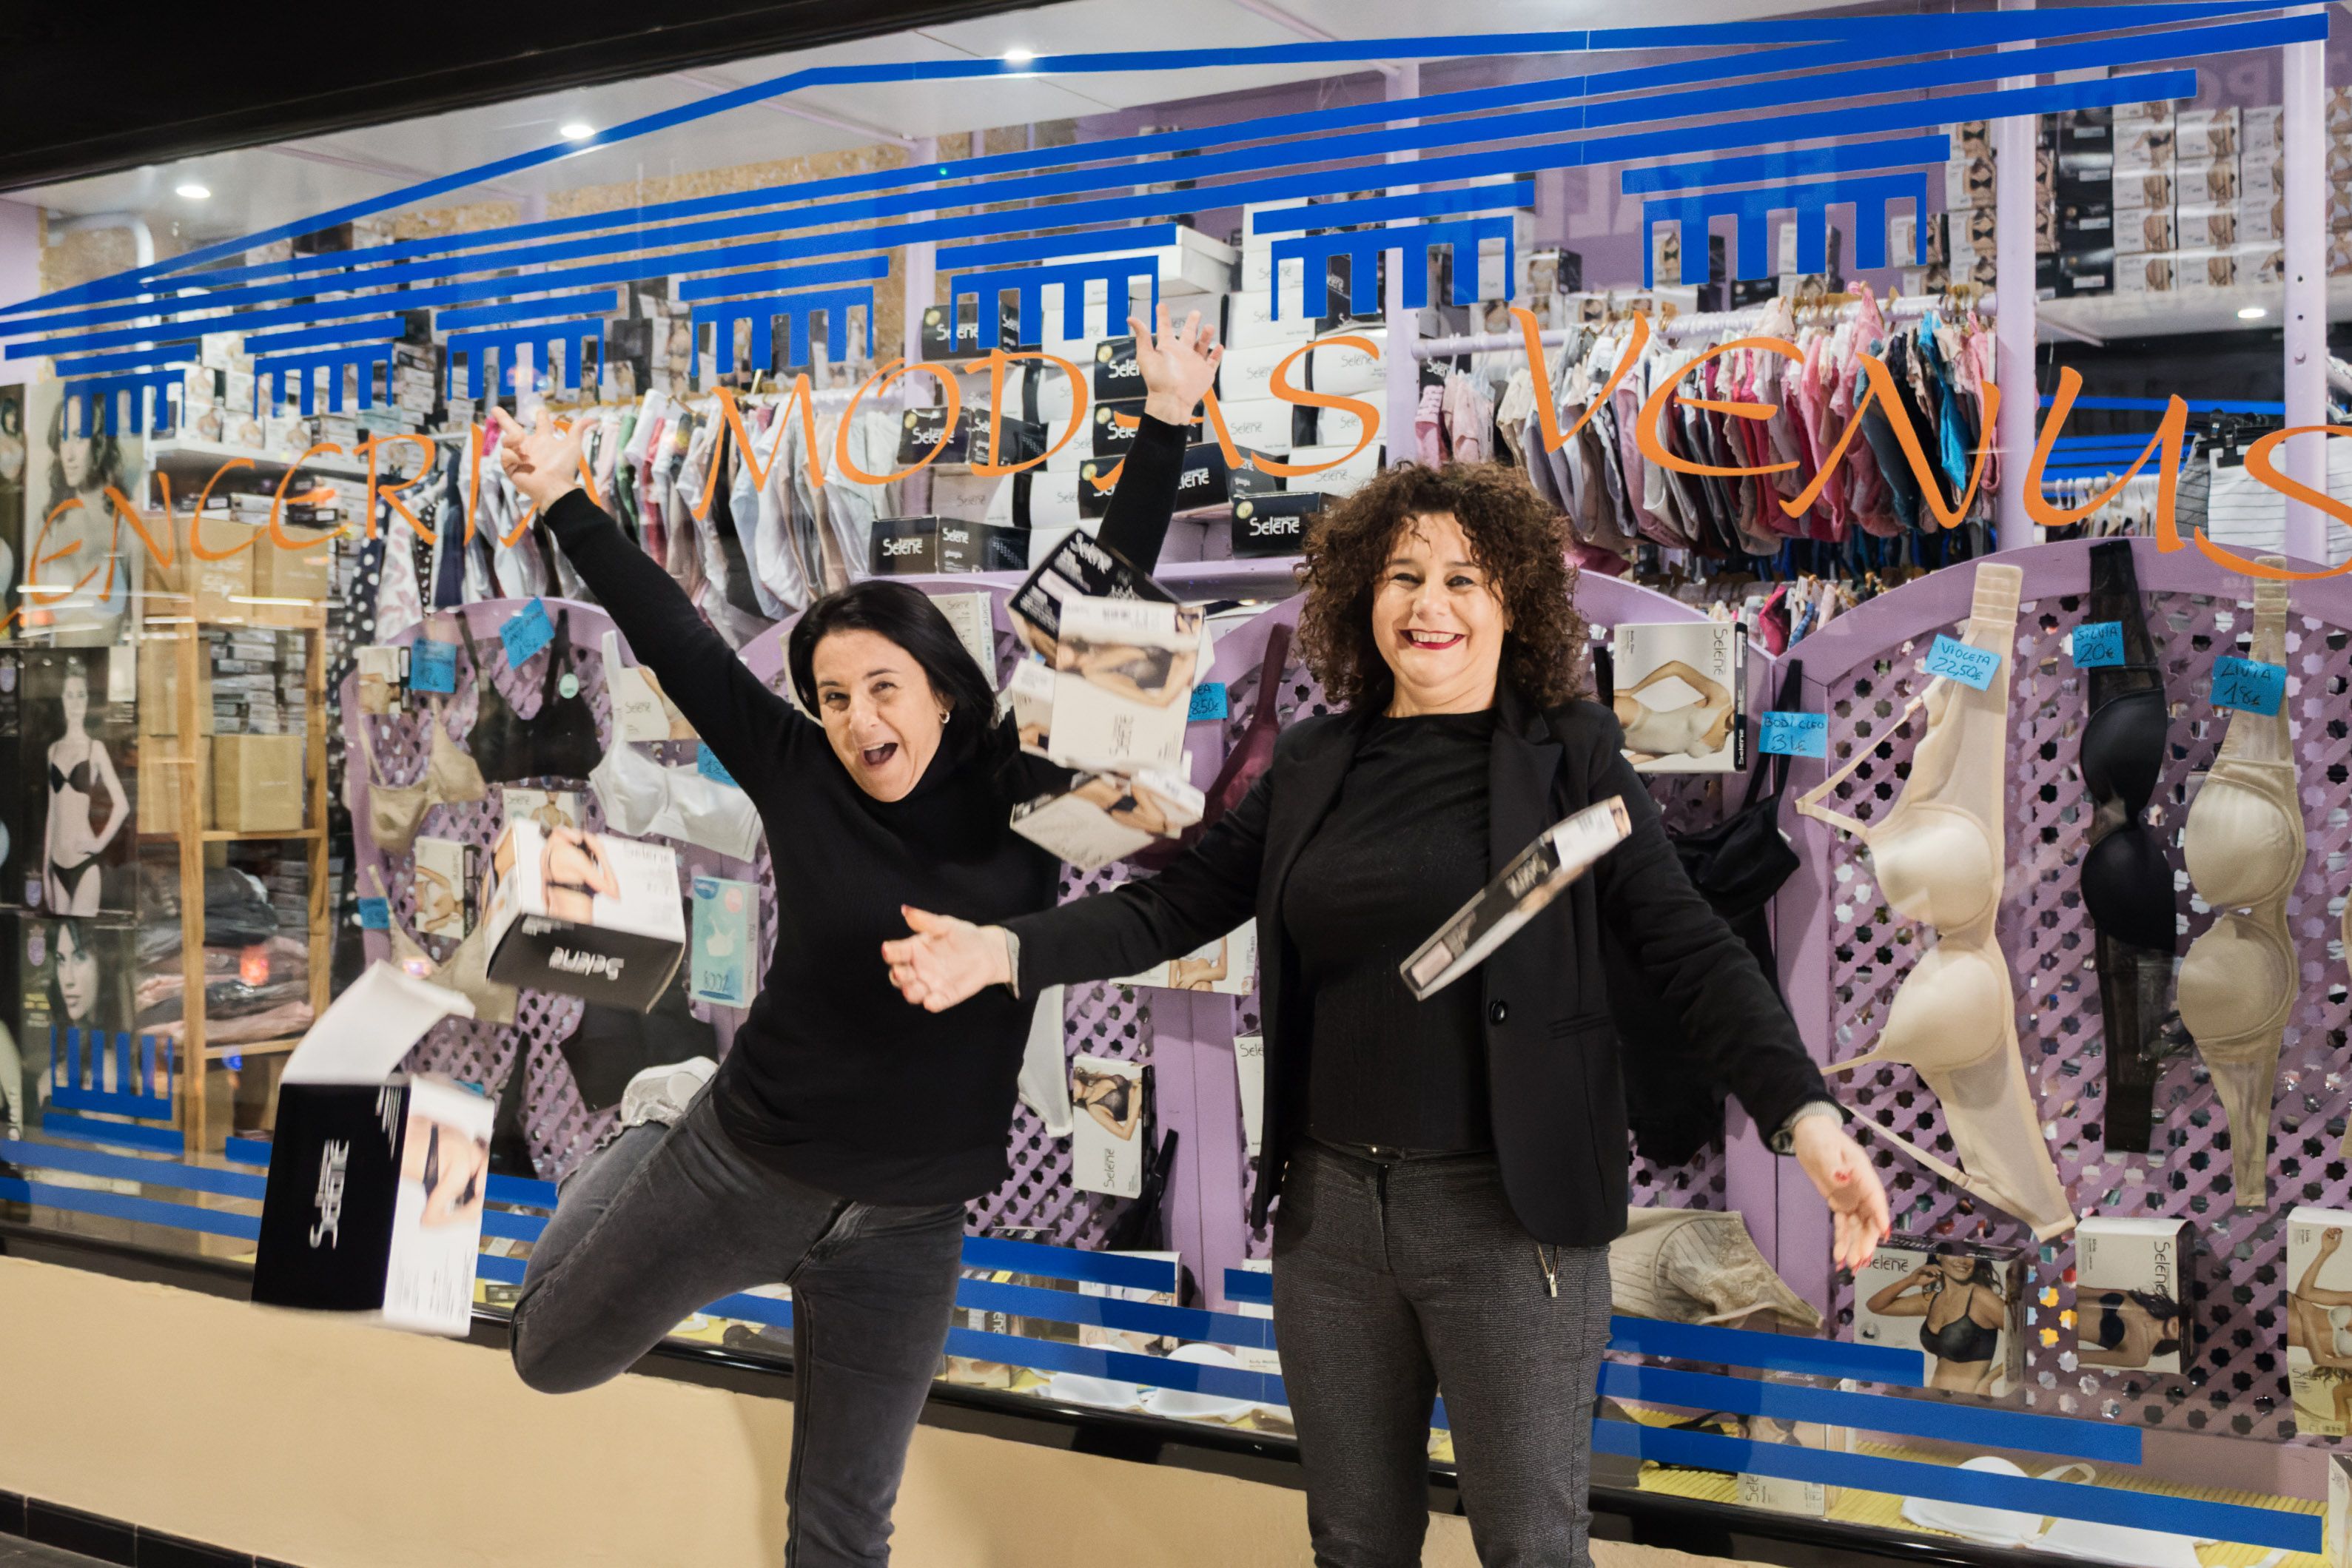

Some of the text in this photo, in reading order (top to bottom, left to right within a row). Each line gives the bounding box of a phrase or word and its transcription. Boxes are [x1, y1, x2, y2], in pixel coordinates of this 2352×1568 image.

[1259, 266, 1292, 280] Sene
[936, 323, 979, 341] Seene
[1108, 357, 1140, 378] Sele
[1246, 366, 1273, 380] Selen
[1230, 422, 1263, 435] Selene
[1340, 416, 1363, 429] Sele
[1509, 306, 2352, 582] VENUS
[1178, 469, 1210, 490] lene
[1249, 517, 1300, 536] Selene
[943, 528, 970, 545] Selene
[882, 538, 924, 556] Selene
[1713, 628, 1728, 676] Selene
[1941, 642, 1991, 665] VIOLETA
[2077, 642, 2114, 664] 20€
[1932, 656, 1983, 681] 22,50€
[1240, 1043, 1264, 1057] Sele
[1103, 1148, 1115, 1189] Selene
[1867, 1255, 1909, 1273] elene
[1745, 1474, 1760, 1503] Sele
